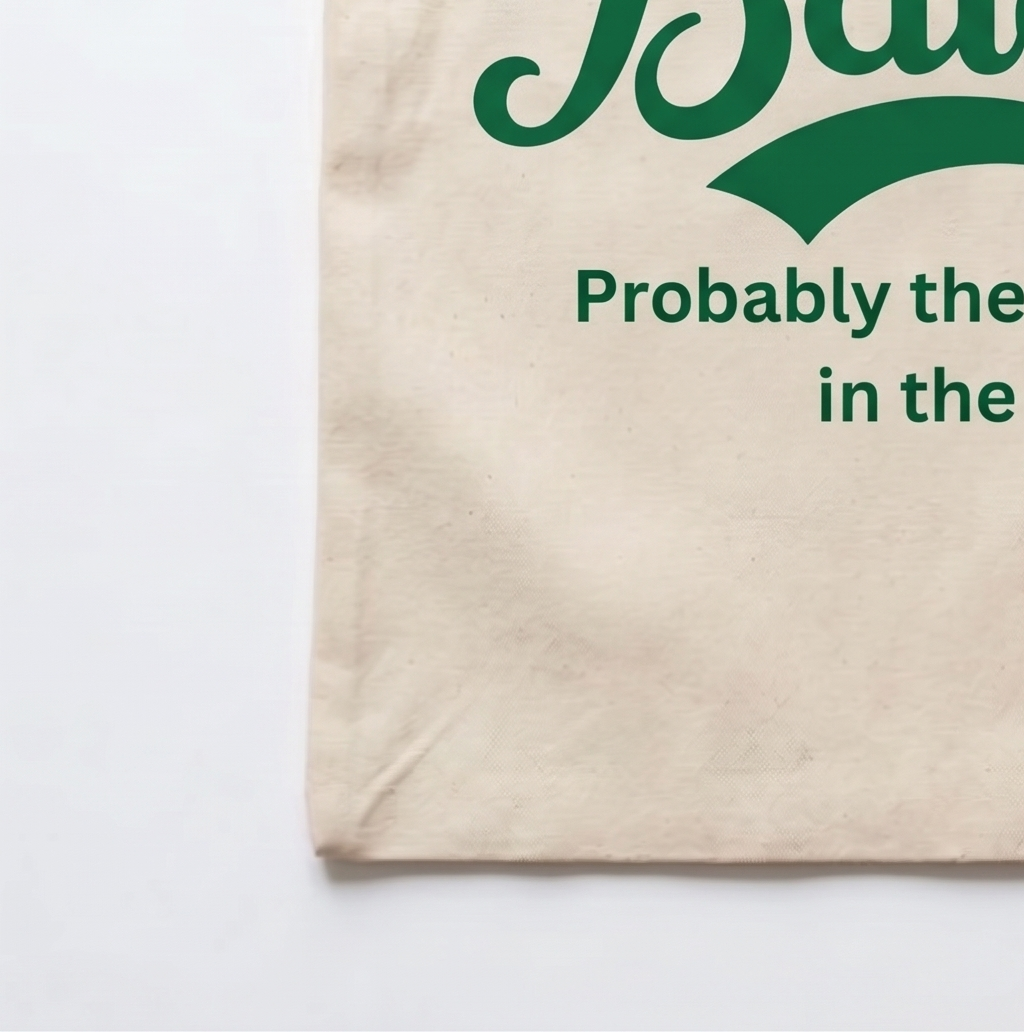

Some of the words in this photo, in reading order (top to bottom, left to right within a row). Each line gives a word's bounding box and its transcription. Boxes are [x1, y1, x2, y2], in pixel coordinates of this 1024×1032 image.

[576, 266, 891, 340] Probably
[909, 266, 1024, 324] the
[819, 366, 879, 423] in
[900, 366, 1016, 424] the
